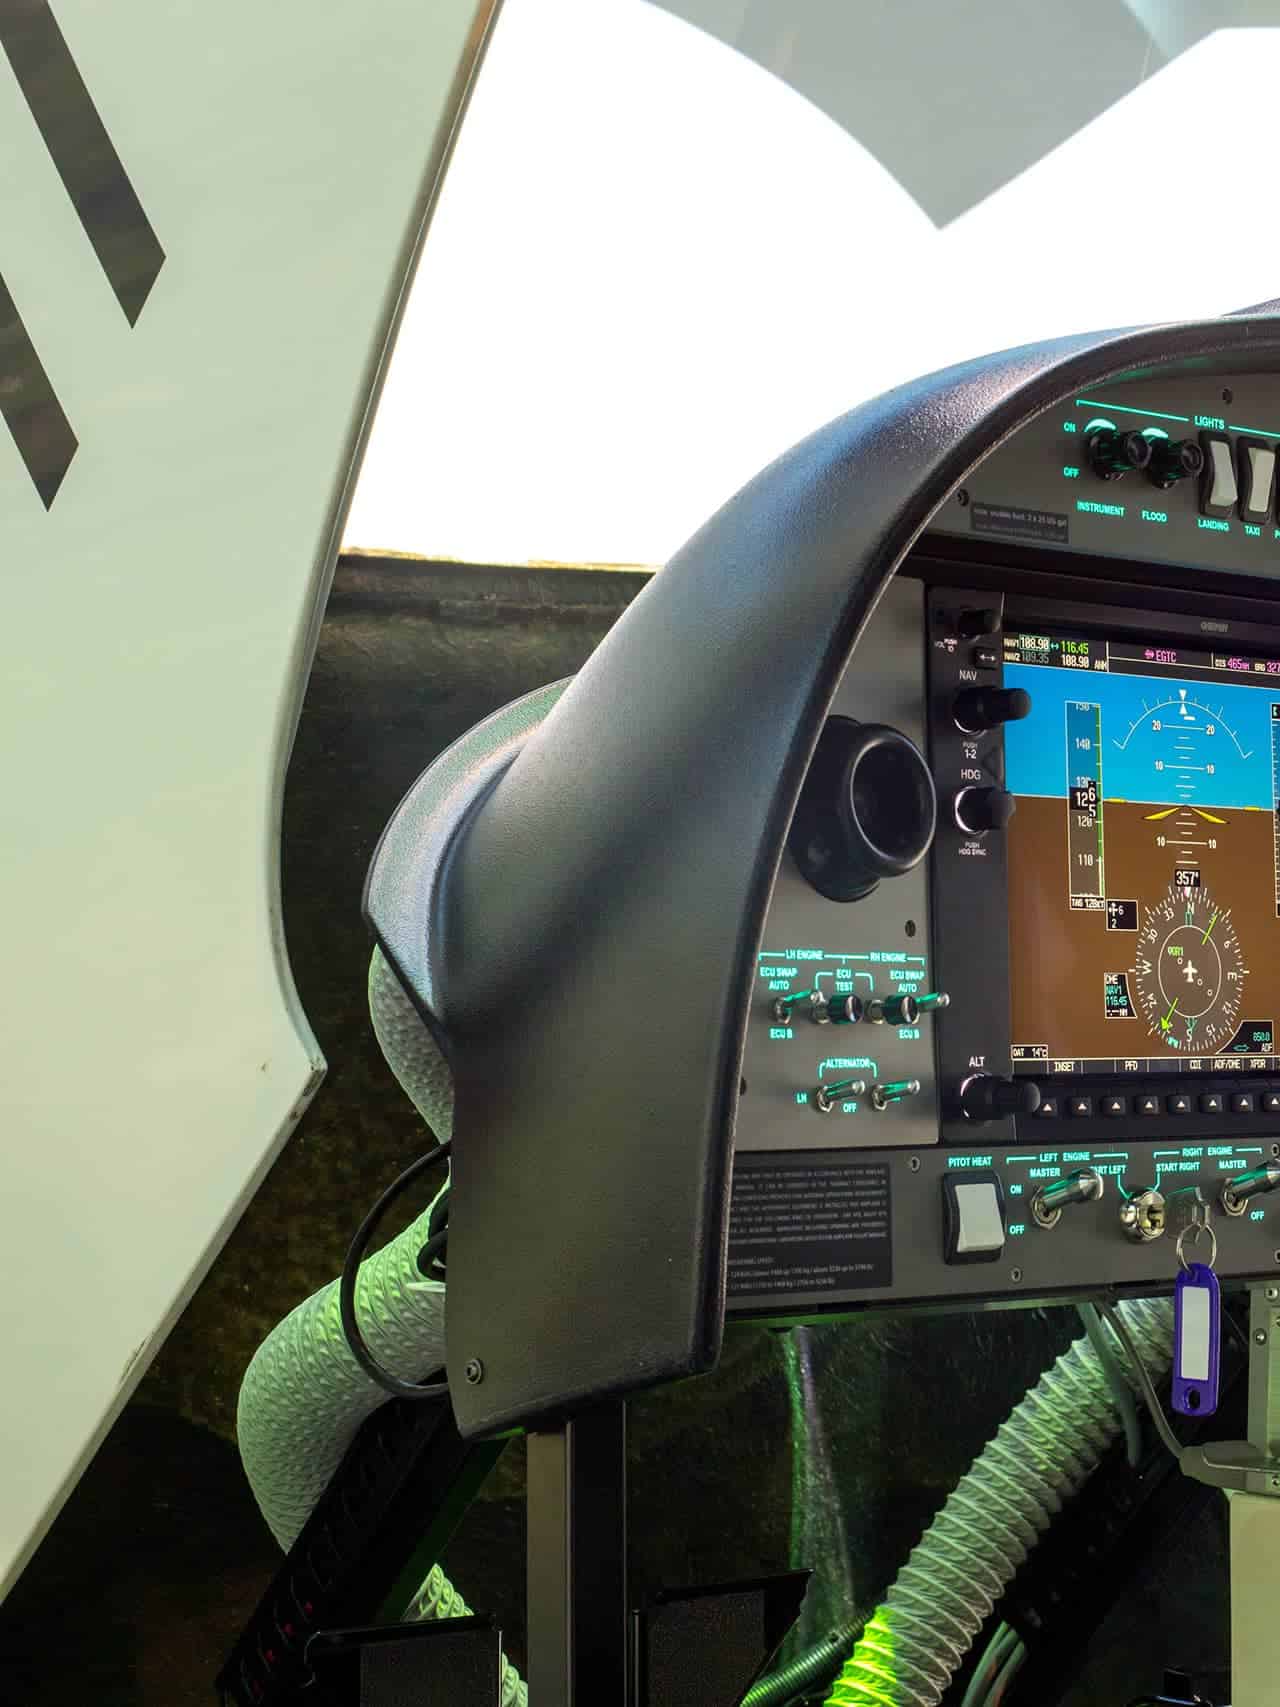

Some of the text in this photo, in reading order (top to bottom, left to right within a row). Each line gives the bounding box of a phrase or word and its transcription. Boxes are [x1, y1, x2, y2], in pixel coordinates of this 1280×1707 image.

[1063, 422, 1076, 433] ON
[1194, 416, 1225, 430] LIGHTS
[1063, 466, 1080, 478] OFF
[1077, 501, 1126, 517] INSTRUMENT
[1142, 510, 1167, 522] FLOOD
[1197, 518, 1229, 532] LANDING
[1244, 525, 1261, 536] TAXI
[1060, 640, 1089, 655] 116.45
[1155, 650, 1177, 664] EGTC
[959, 669, 977, 681] NAV
[1152, 720, 1161, 731] 20
[1206, 725, 1215, 736] 20
[1076, 738, 1091, 750] 140
[964, 749, 977, 759] 1-2
[1155, 760, 1164, 771] 10
[1206, 764, 1215, 775] 10
[961, 769, 981, 780] HDG
[1078, 815, 1092, 827] 120
[1156, 836, 1166, 847] 10
[1208, 839, 1217, 849] 10
[1078, 854, 1093, 866] 110
[1118, 905, 1124, 916] 6
[1187, 902, 1194, 914] N
[1163, 907, 1175, 921] 33
[1111, 919, 1118, 929] 2
[1148, 929, 1158, 944] 30
[1224, 940, 1231, 949] 6
[785, 950, 824, 960] LH ENGINE
[870, 952, 906, 962] RH ENGINE
[760, 967, 798, 977] ECU SWAP
[836, 968, 851, 978] ECU
[1142, 960, 1152, 975] W
[889, 970, 925, 981] ECU SWAP
[1228, 971, 1237, 981] E
[768, 980, 790, 991] AUTO
[835, 981, 853, 992] TEST
[898, 983, 917, 993] AUTO
[770, 1028, 793, 1039] ECU B
[899, 1028, 920, 1039] ECU B
[1186, 1031, 1193, 1042] S
[1013, 1047, 1025, 1057] OAT
[825, 1058, 870, 1069] ALTERNATOR
[969, 1056, 985, 1068] ALT
[1054, 1061, 1075, 1072] INSET
[1124, 1061, 1138, 1071] PFD
[796, 1093, 807, 1104] LH
[843, 1103, 856, 1113] OFF
[1039, 1152, 1090, 1163] LEFT ENGINE
[1182, 1146, 1233, 1158] RIGHT ENGINE
[948, 1156, 992, 1168] PITOT HEAT
[1156, 1161, 1200, 1172] START RIGHT
[1219, 1159, 1247, 1169] MASTER
[1029, 1167, 1061, 1178] MASTER
[1109, 1165, 1127, 1175] LEFT
[1010, 1184, 1022, 1195] ON
[1250, 1210, 1265, 1221] OFF
[1009, 1224, 1025, 1235] OFF
